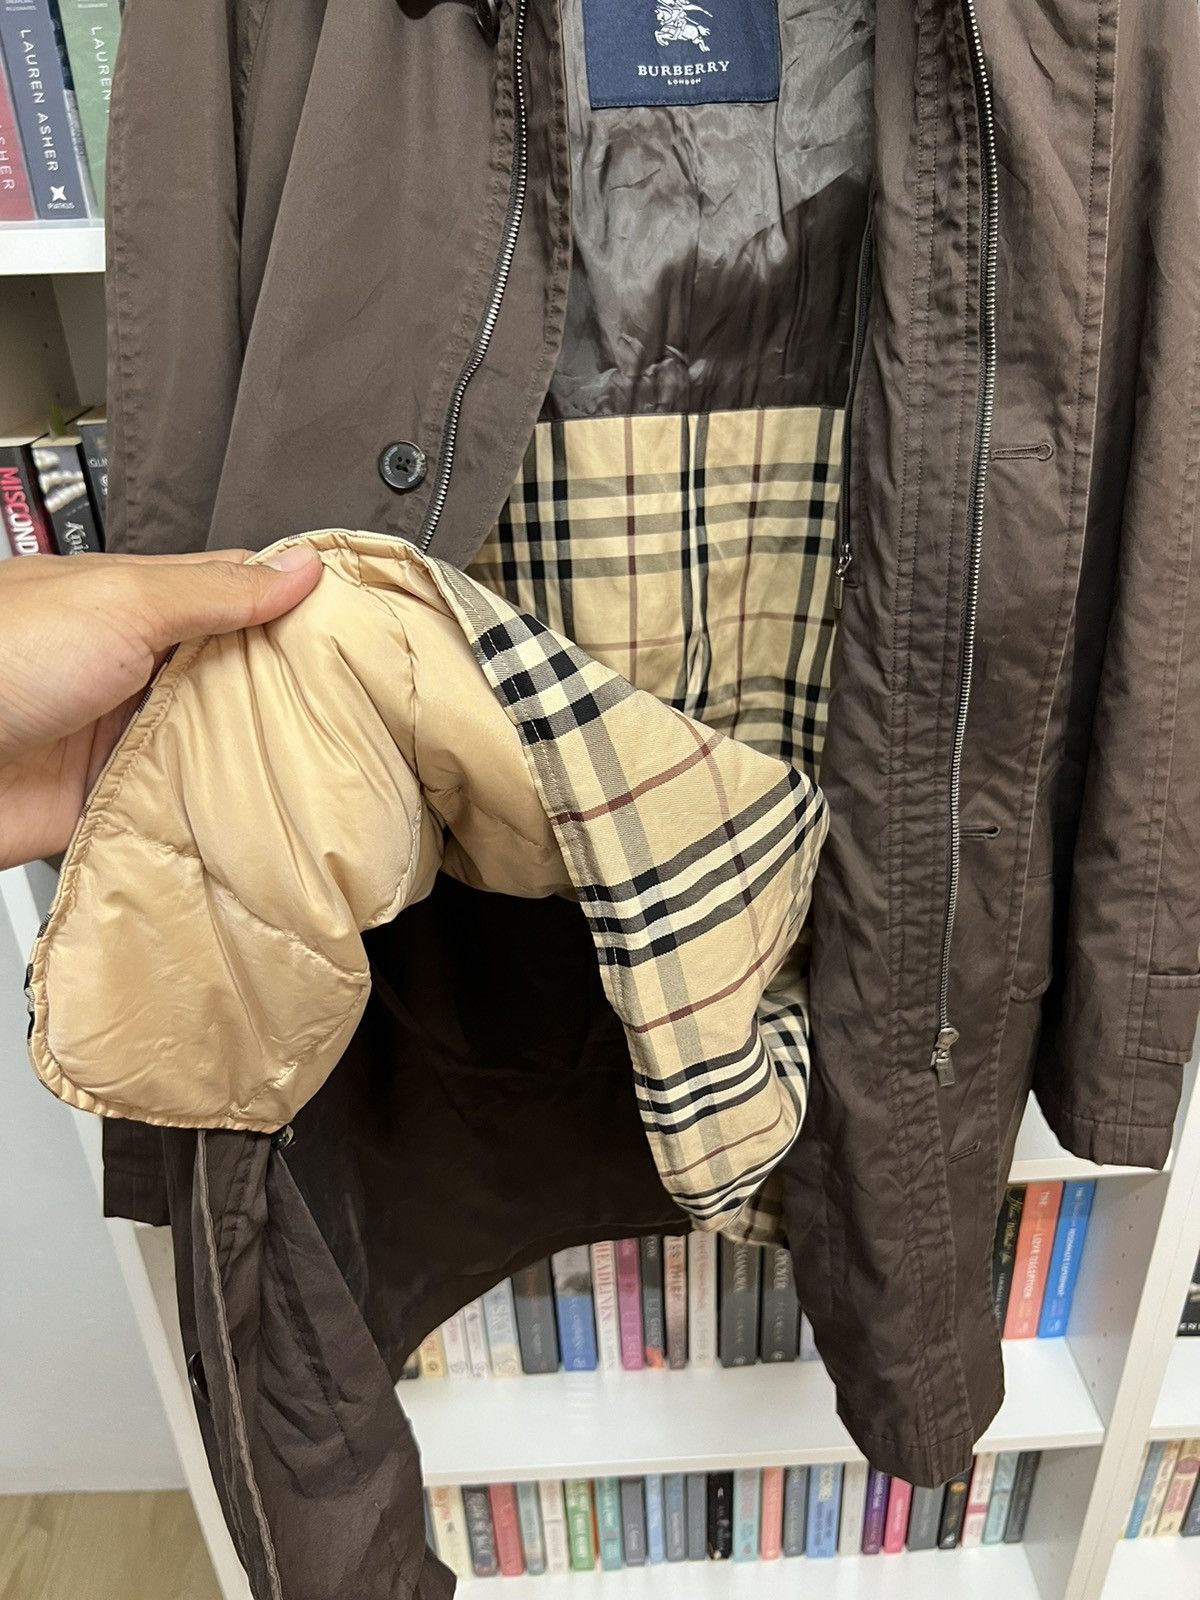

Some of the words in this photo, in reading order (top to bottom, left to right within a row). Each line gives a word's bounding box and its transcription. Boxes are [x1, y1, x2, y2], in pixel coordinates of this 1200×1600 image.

[20, 29, 45, 104] LAUREN
[37, 112, 59, 171] ASHER
[91, 26, 112, 100] LAUREN
[637, 60, 730, 77] BURBERRY
[667, 78, 701, 86] LONDON
[0, 466, 40, 555] MISCOND
